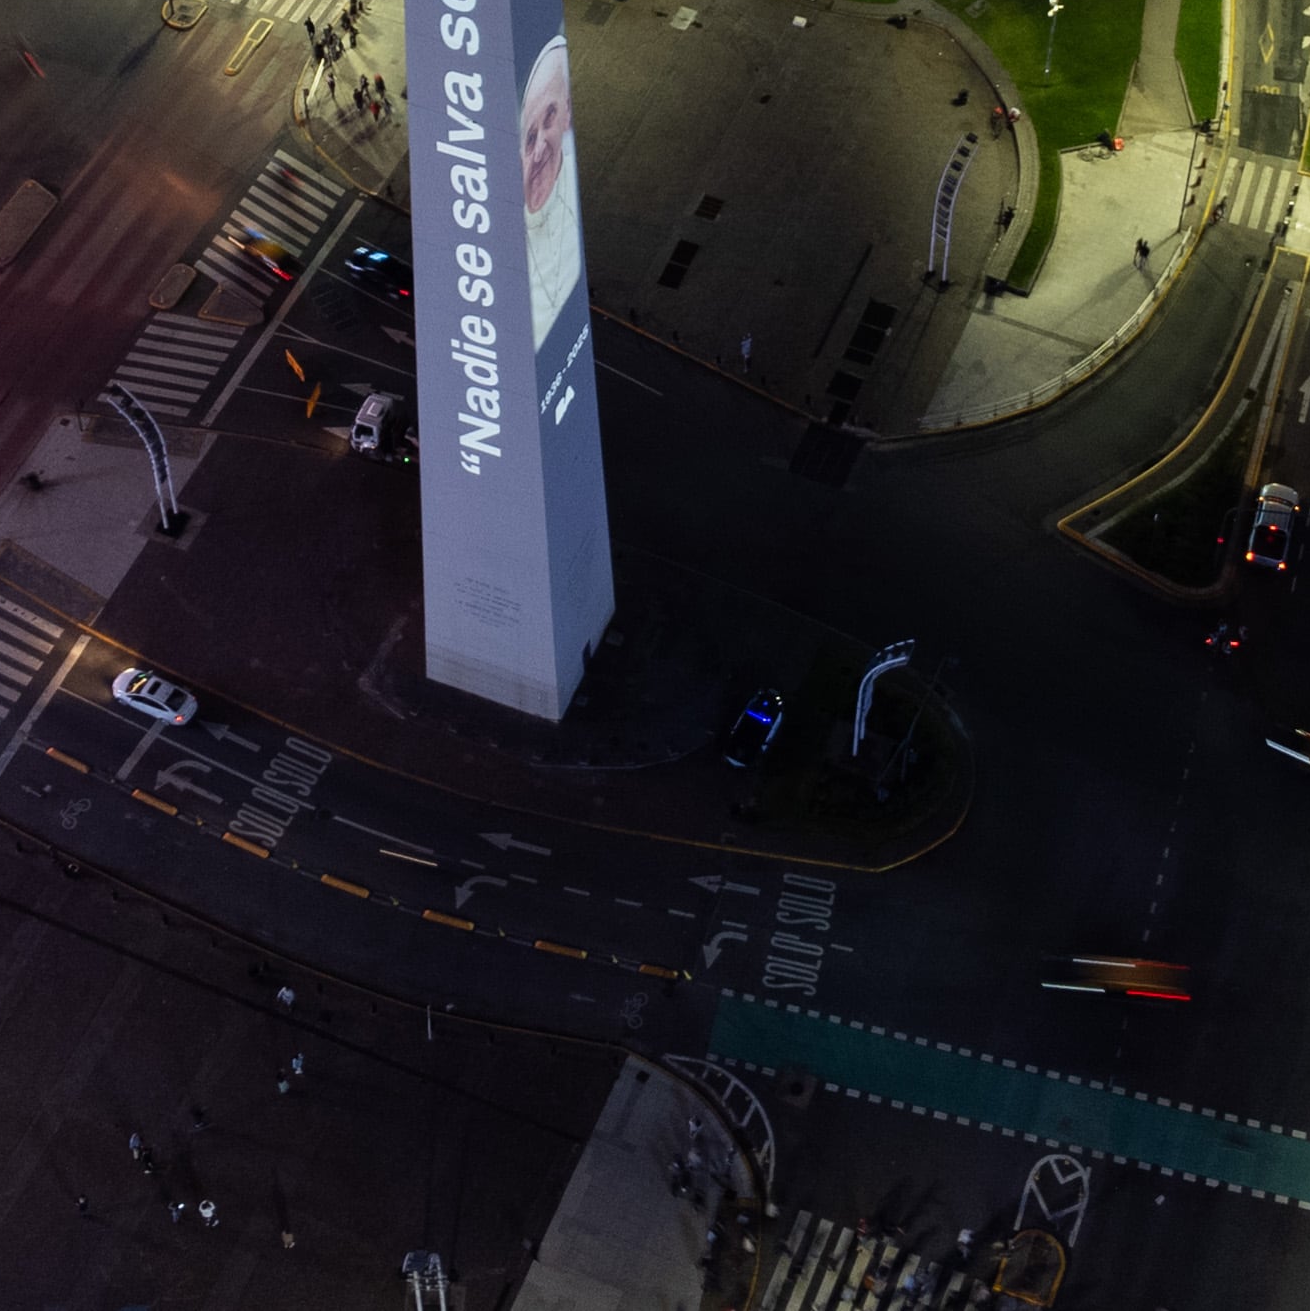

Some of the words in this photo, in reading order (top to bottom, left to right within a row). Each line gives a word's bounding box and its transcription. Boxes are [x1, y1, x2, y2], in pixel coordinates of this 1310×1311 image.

[436, 71, 491, 234] salva
[455, 243, 494, 307] se
[450, 315, 502, 475] “Nadie
[262, 736, 333, 797] SOLO
[229, 786, 300, 848] SOLO
[776, 872, 837, 931] SOLO
[762, 935, 824, 996] SOLO
